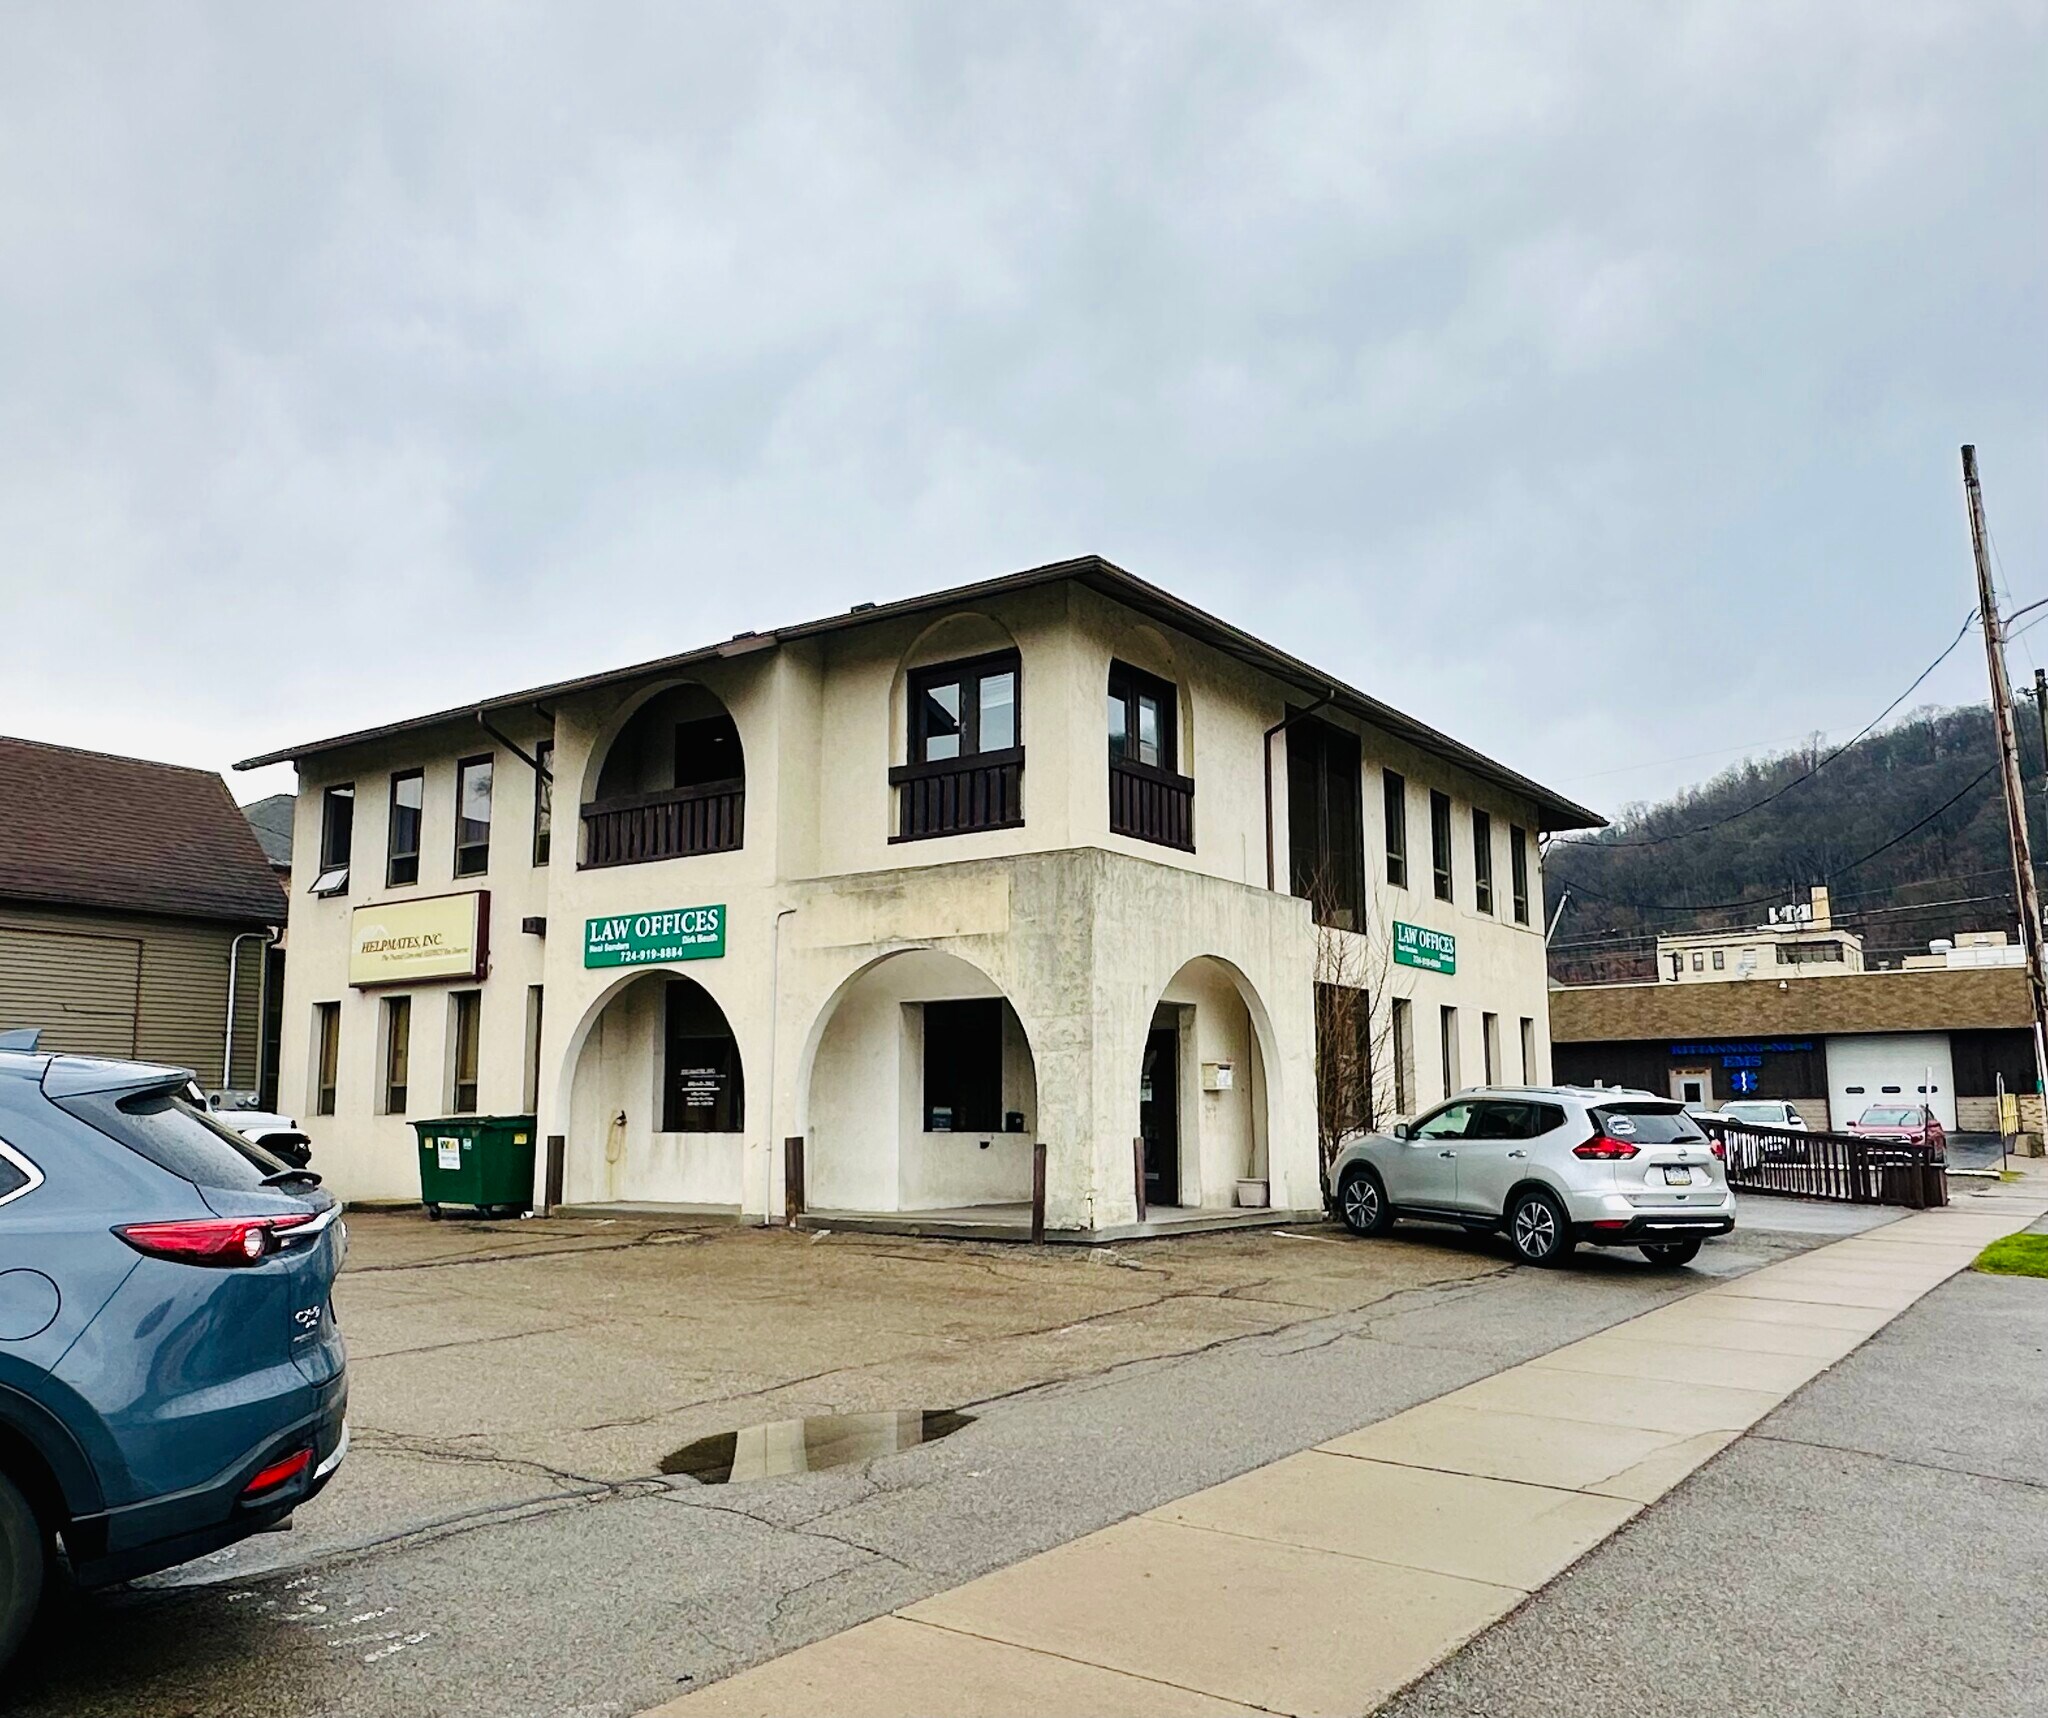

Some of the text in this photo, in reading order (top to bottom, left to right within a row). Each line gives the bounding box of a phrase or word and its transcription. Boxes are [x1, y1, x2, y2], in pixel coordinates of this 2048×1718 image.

[589, 909, 719, 942] LAW OFFICES
[1397, 924, 1418, 946] LAW
[1418, 930, 1454, 955] OFFICES
[1721, 1055, 1763, 1067] EMS
